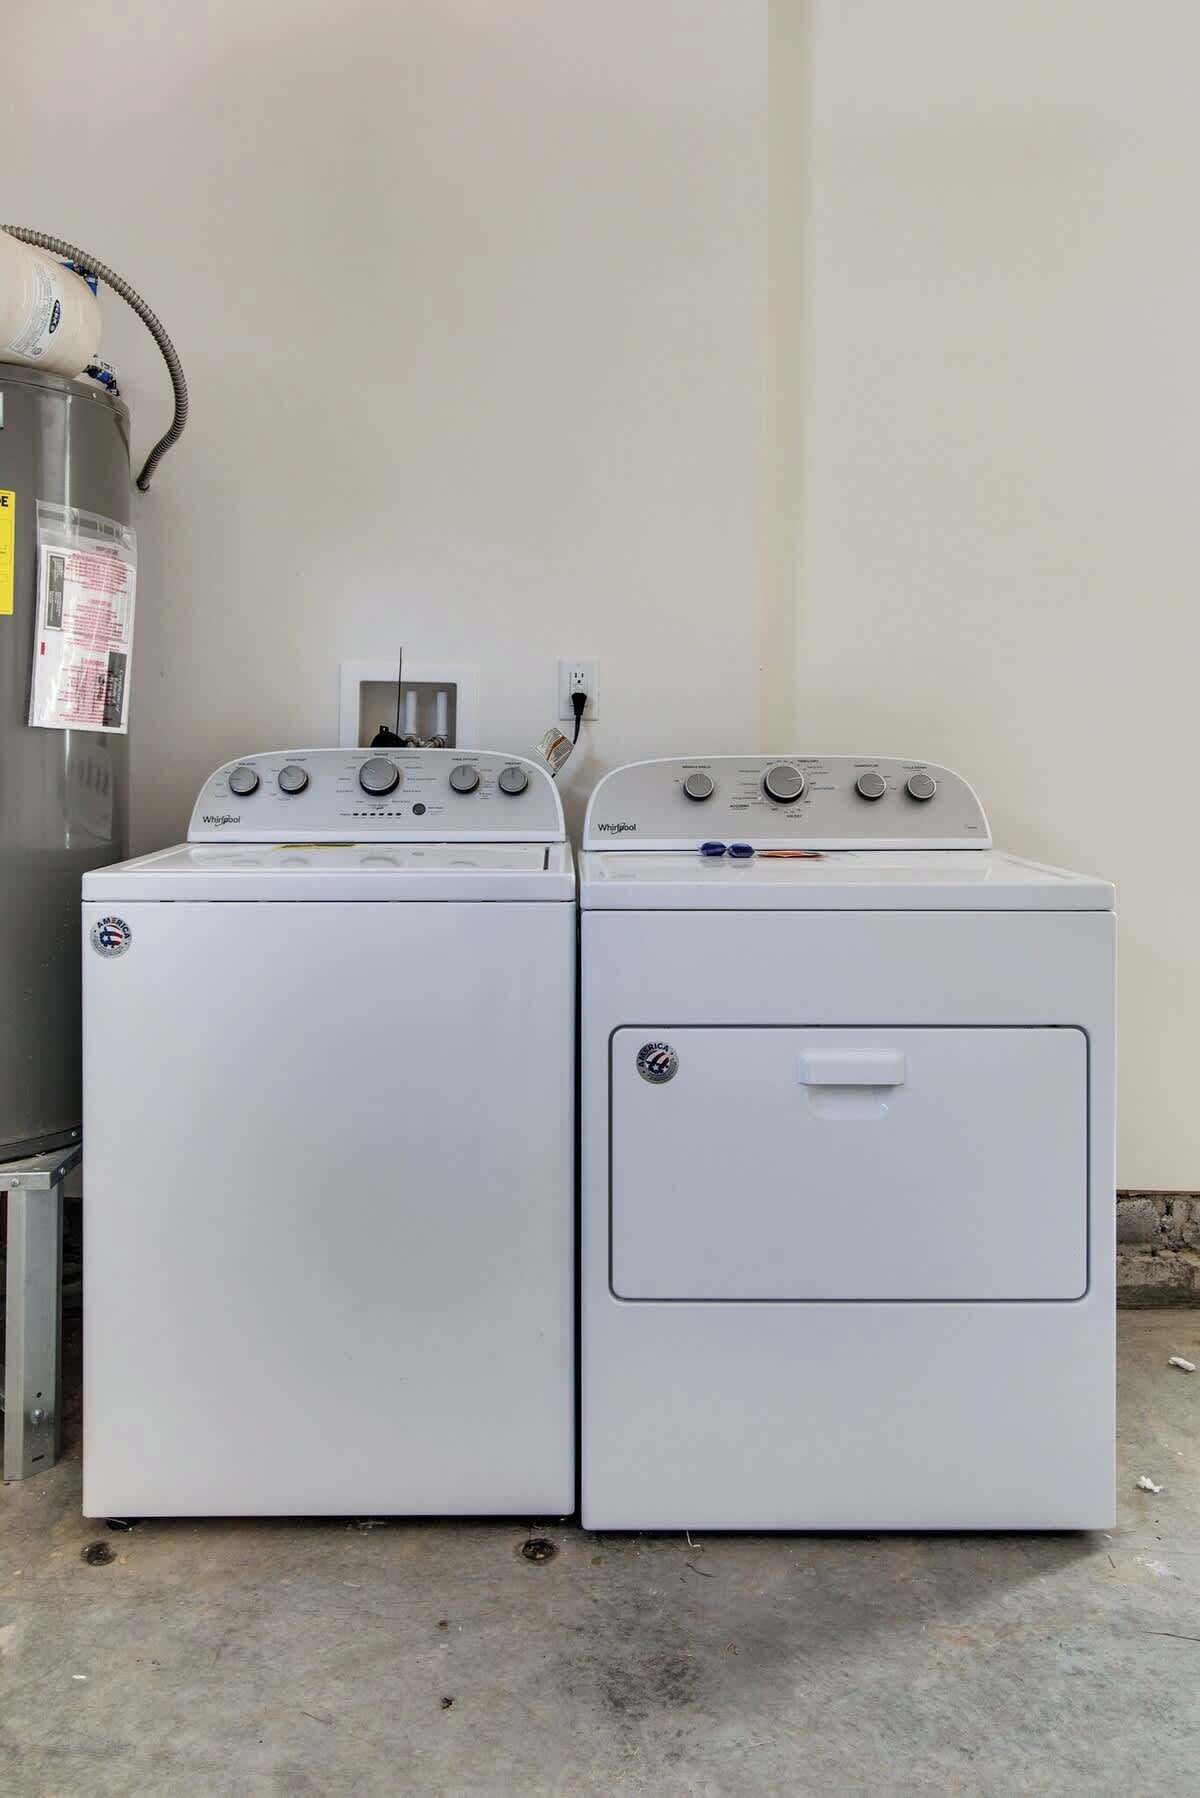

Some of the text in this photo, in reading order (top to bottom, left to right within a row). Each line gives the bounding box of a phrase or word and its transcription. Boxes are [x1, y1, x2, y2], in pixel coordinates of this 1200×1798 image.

[202, 815, 241, 826] Whirlpool
[598, 822, 637, 834] Whirlpool
[97, 916, 130, 939] AMERICA
[638, 1042, 669, 1068] AMERICA
